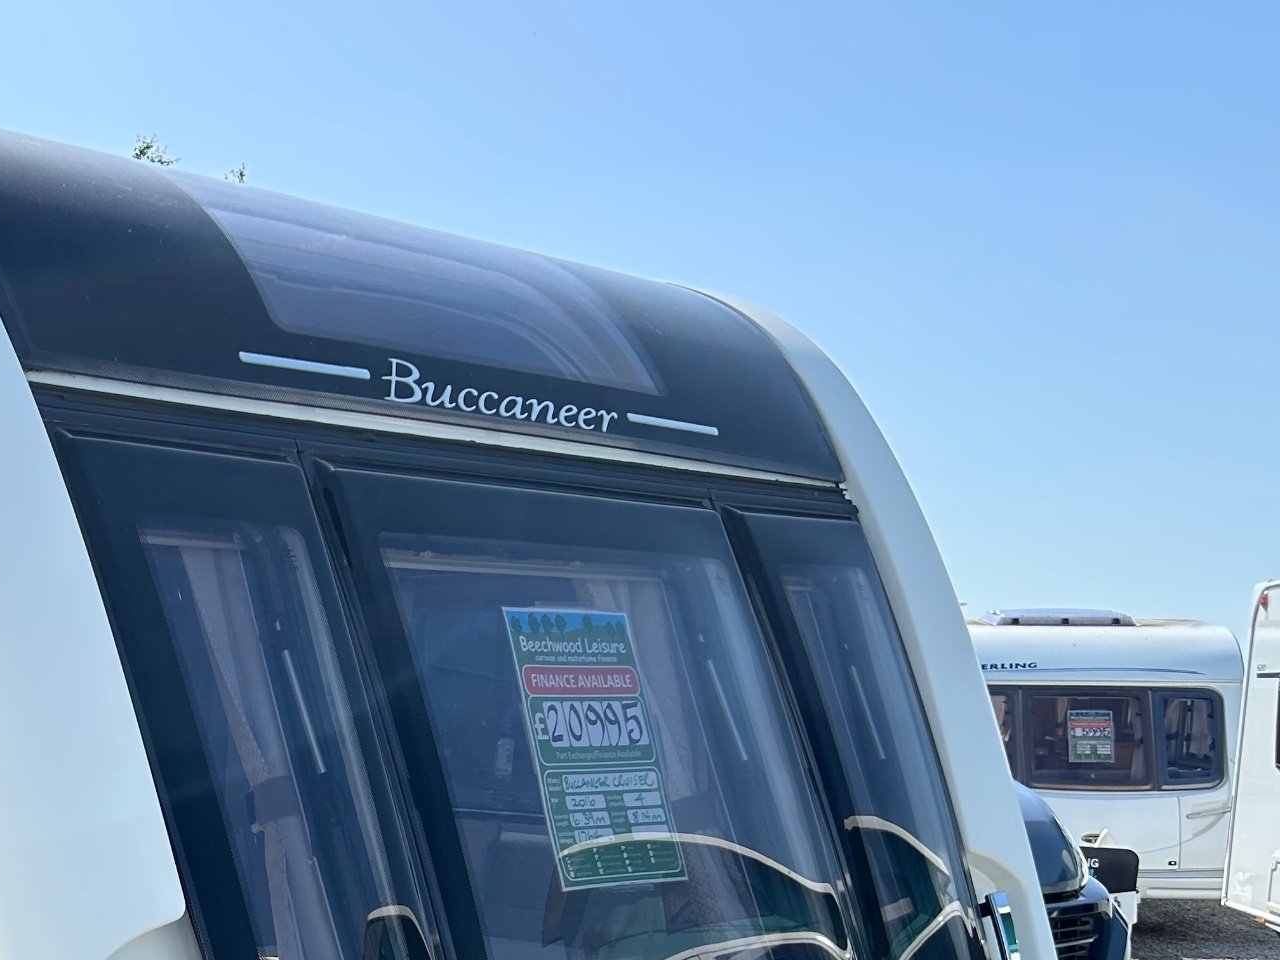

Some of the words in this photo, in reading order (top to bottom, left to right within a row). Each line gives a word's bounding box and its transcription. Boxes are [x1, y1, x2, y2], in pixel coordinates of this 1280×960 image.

[381, 357, 618, 433] Buccaneer
[519, 635, 582, 653] Beechwood
[584, 637, 626, 654] Leisure
[531, 673, 576, 688] FINANCE
[578, 674, 632, 688] AVAILABLE
